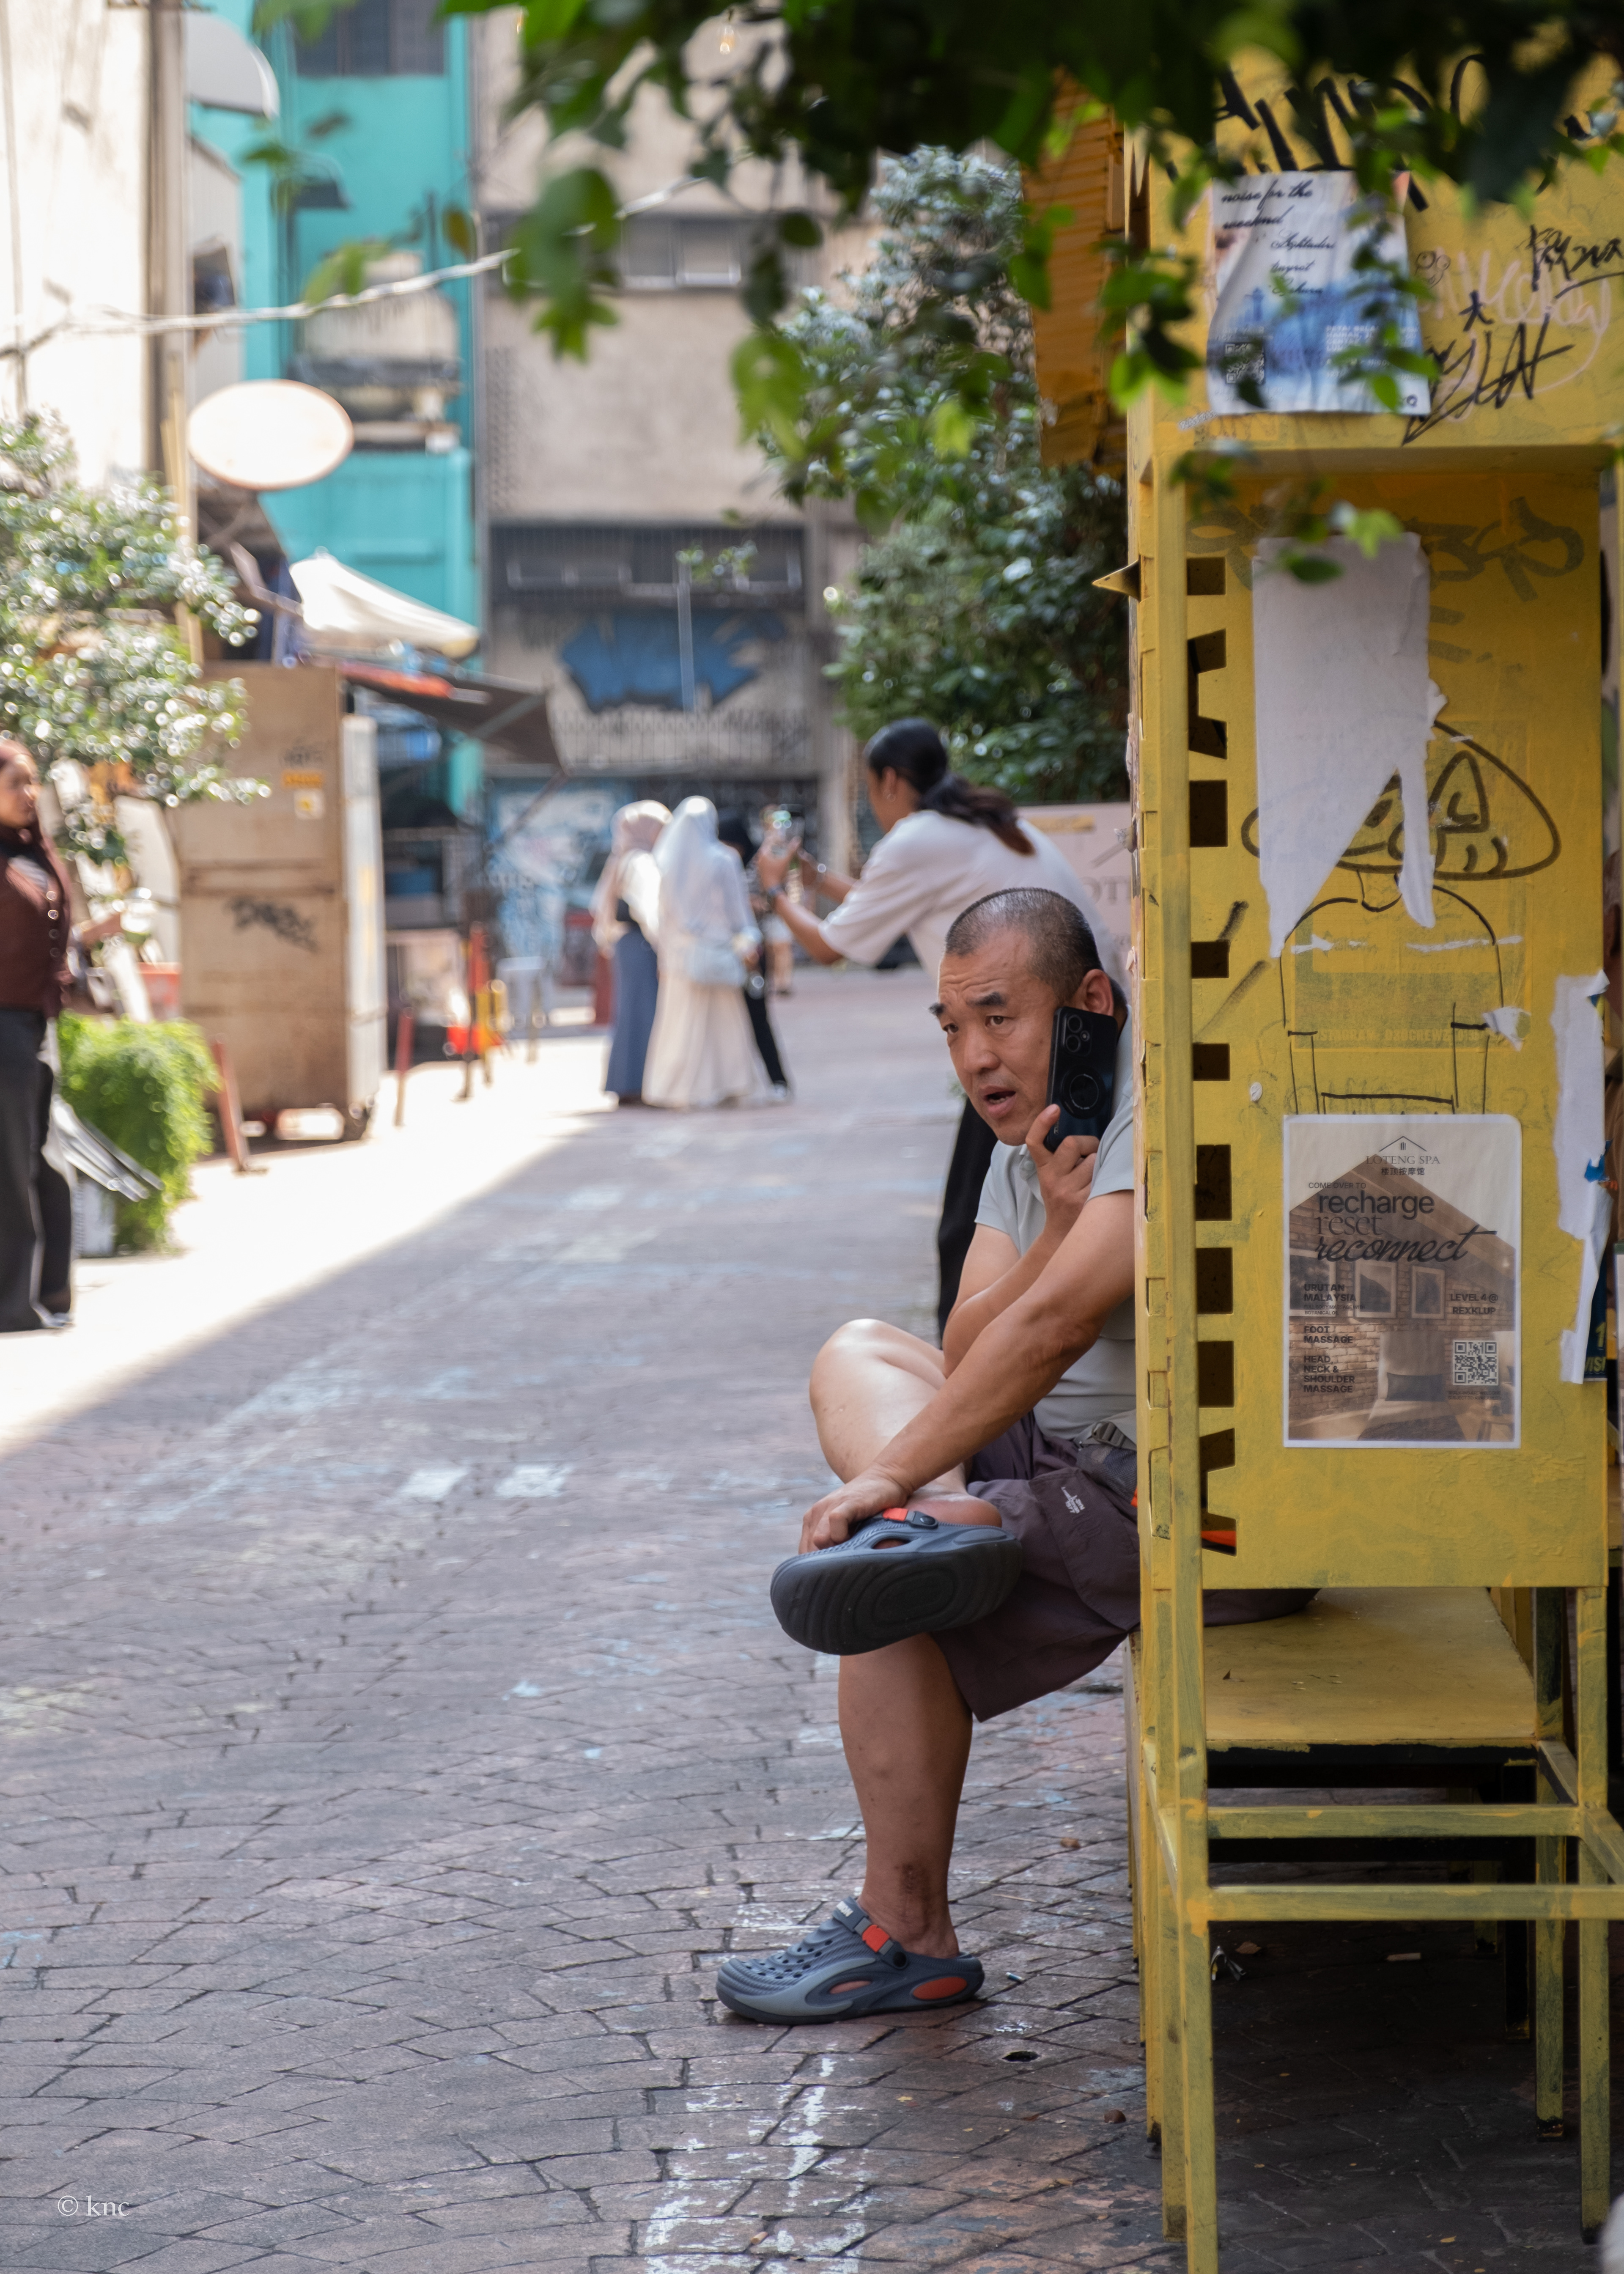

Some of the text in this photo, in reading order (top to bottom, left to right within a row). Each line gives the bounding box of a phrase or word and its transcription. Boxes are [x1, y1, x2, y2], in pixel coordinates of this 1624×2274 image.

[1257, 179, 1284, 210] for
[1288, 179, 1313, 197] the
[1366, 1155, 1440, 1164] LOTENG SPA
[1319, 1190, 1435, 1220] recharge
[1315, 1214, 1383, 1236] reset
[1315, 1224, 1498, 1263] reconnect
[1304, 1294, 1356, 1302] MALAYSIA
[1450, 1294, 1479, 1302] LEVEL
[1481, 1294, 1487, 1302] 4
[1304, 1335, 1353, 1343] MASSAGE
[1304, 1355, 1333, 1365] HEAD,
[1304, 1365, 1330, 1373] NECK
[1303, 1385, 1353, 1393] MASSAGE
